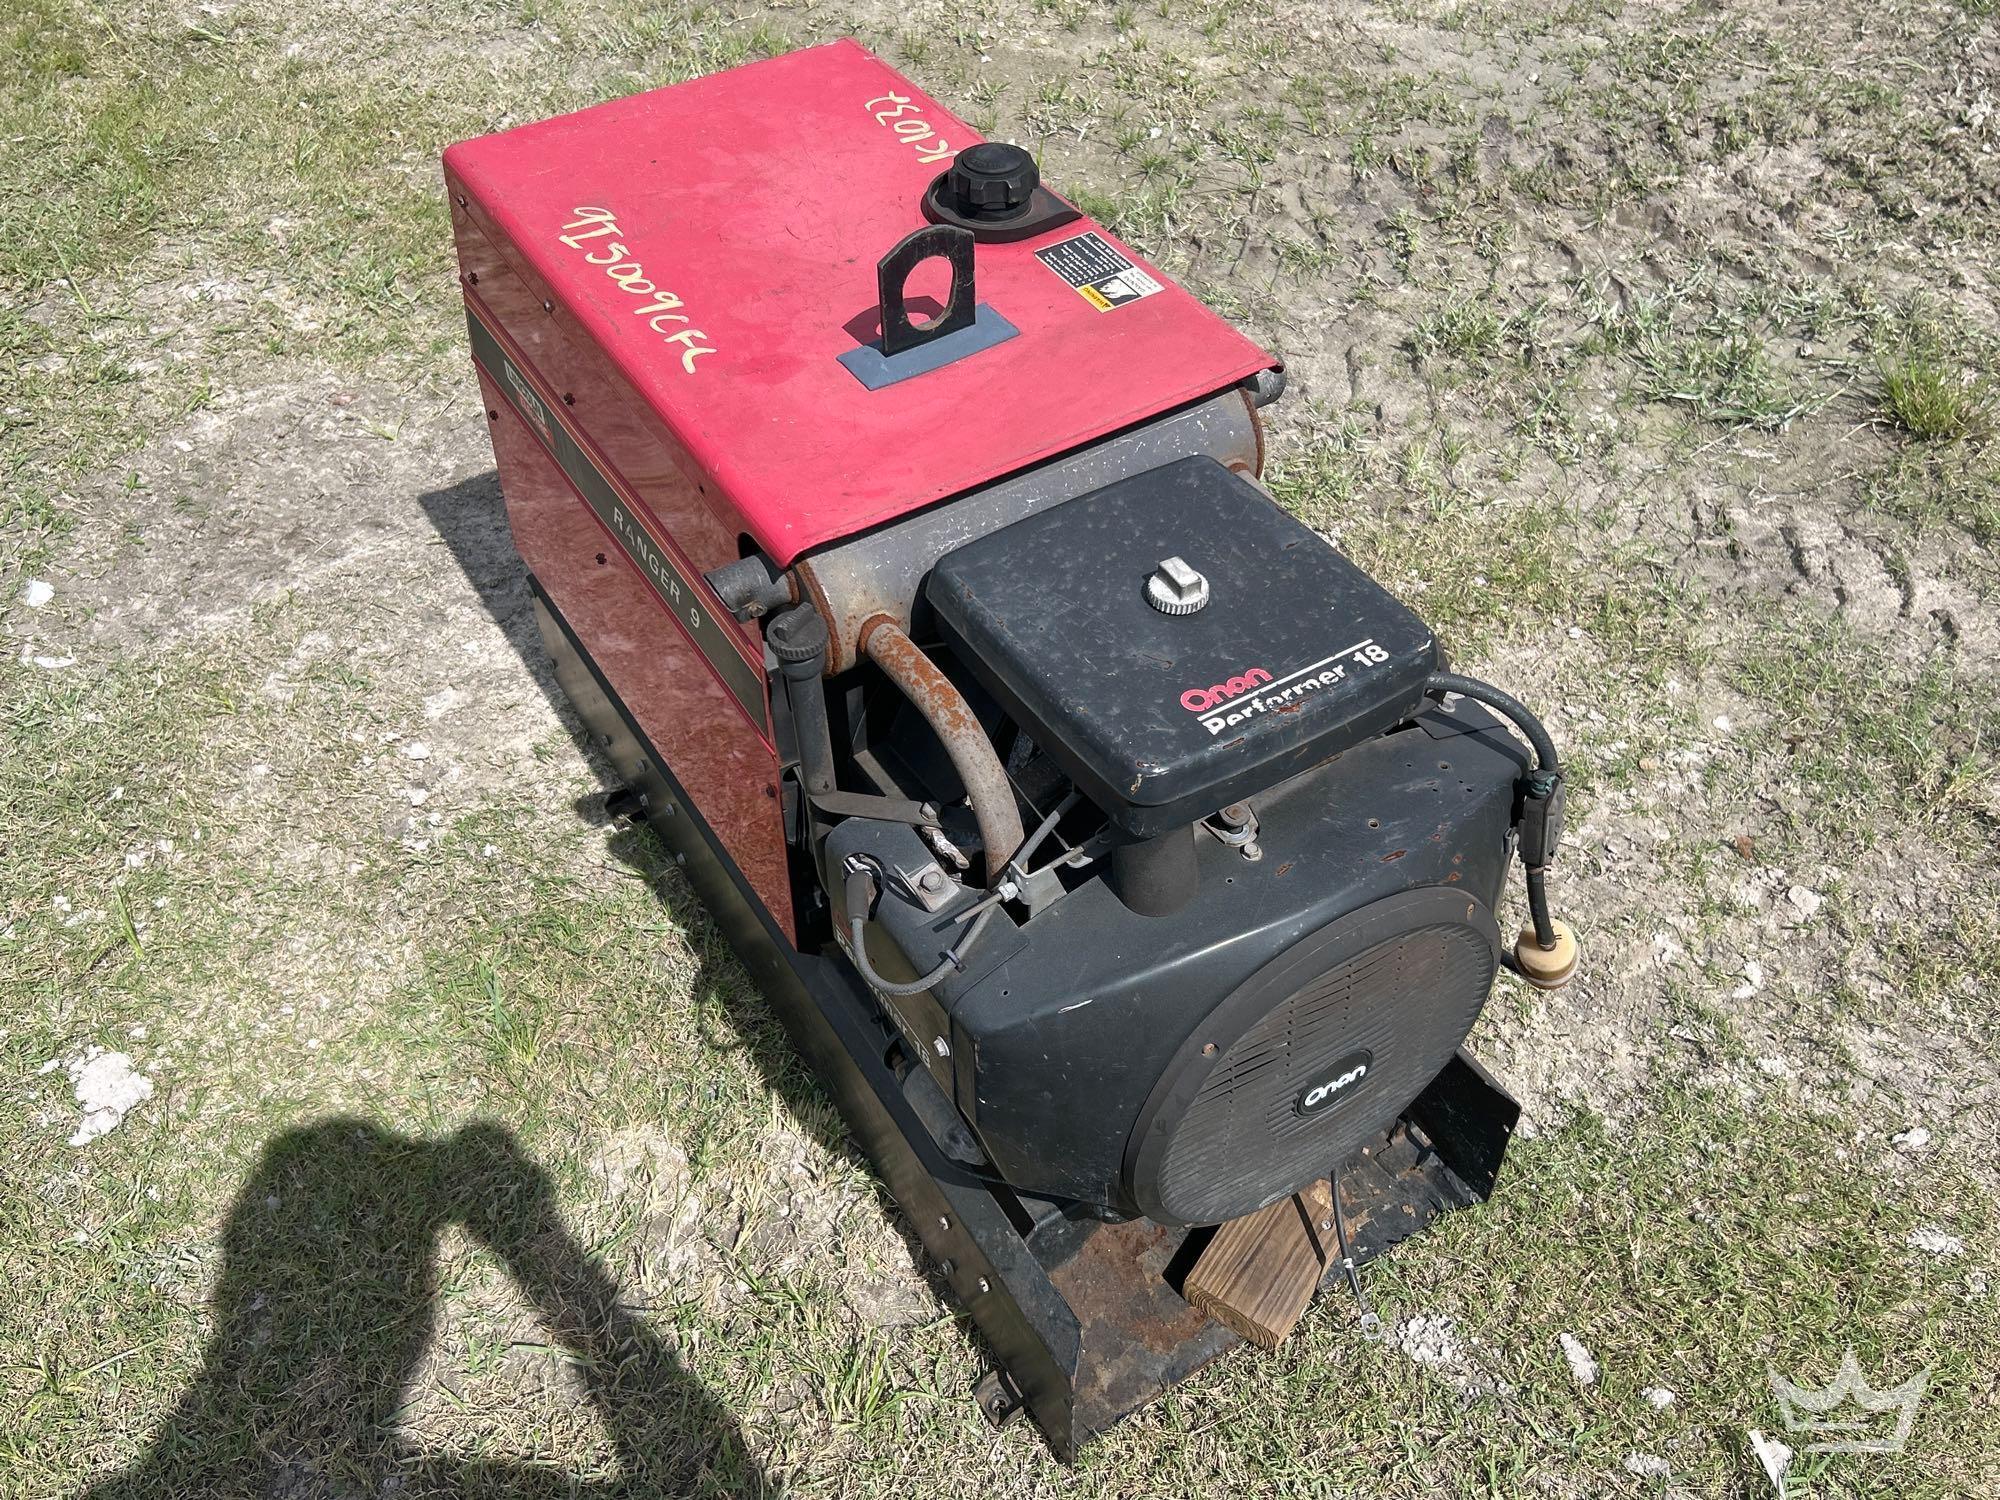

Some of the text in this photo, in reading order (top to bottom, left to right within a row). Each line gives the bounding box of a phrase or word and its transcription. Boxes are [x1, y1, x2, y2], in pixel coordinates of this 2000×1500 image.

[864, 90, 960, 164] K1032
[613, 506, 701, 629] RANGER 9
[1179, 668, 1274, 712] Onan
[1201, 643, 1391, 736] Performer 18
[835, 928, 932, 1069] Permer 18
[1304, 1065, 1367, 1107] Onan
